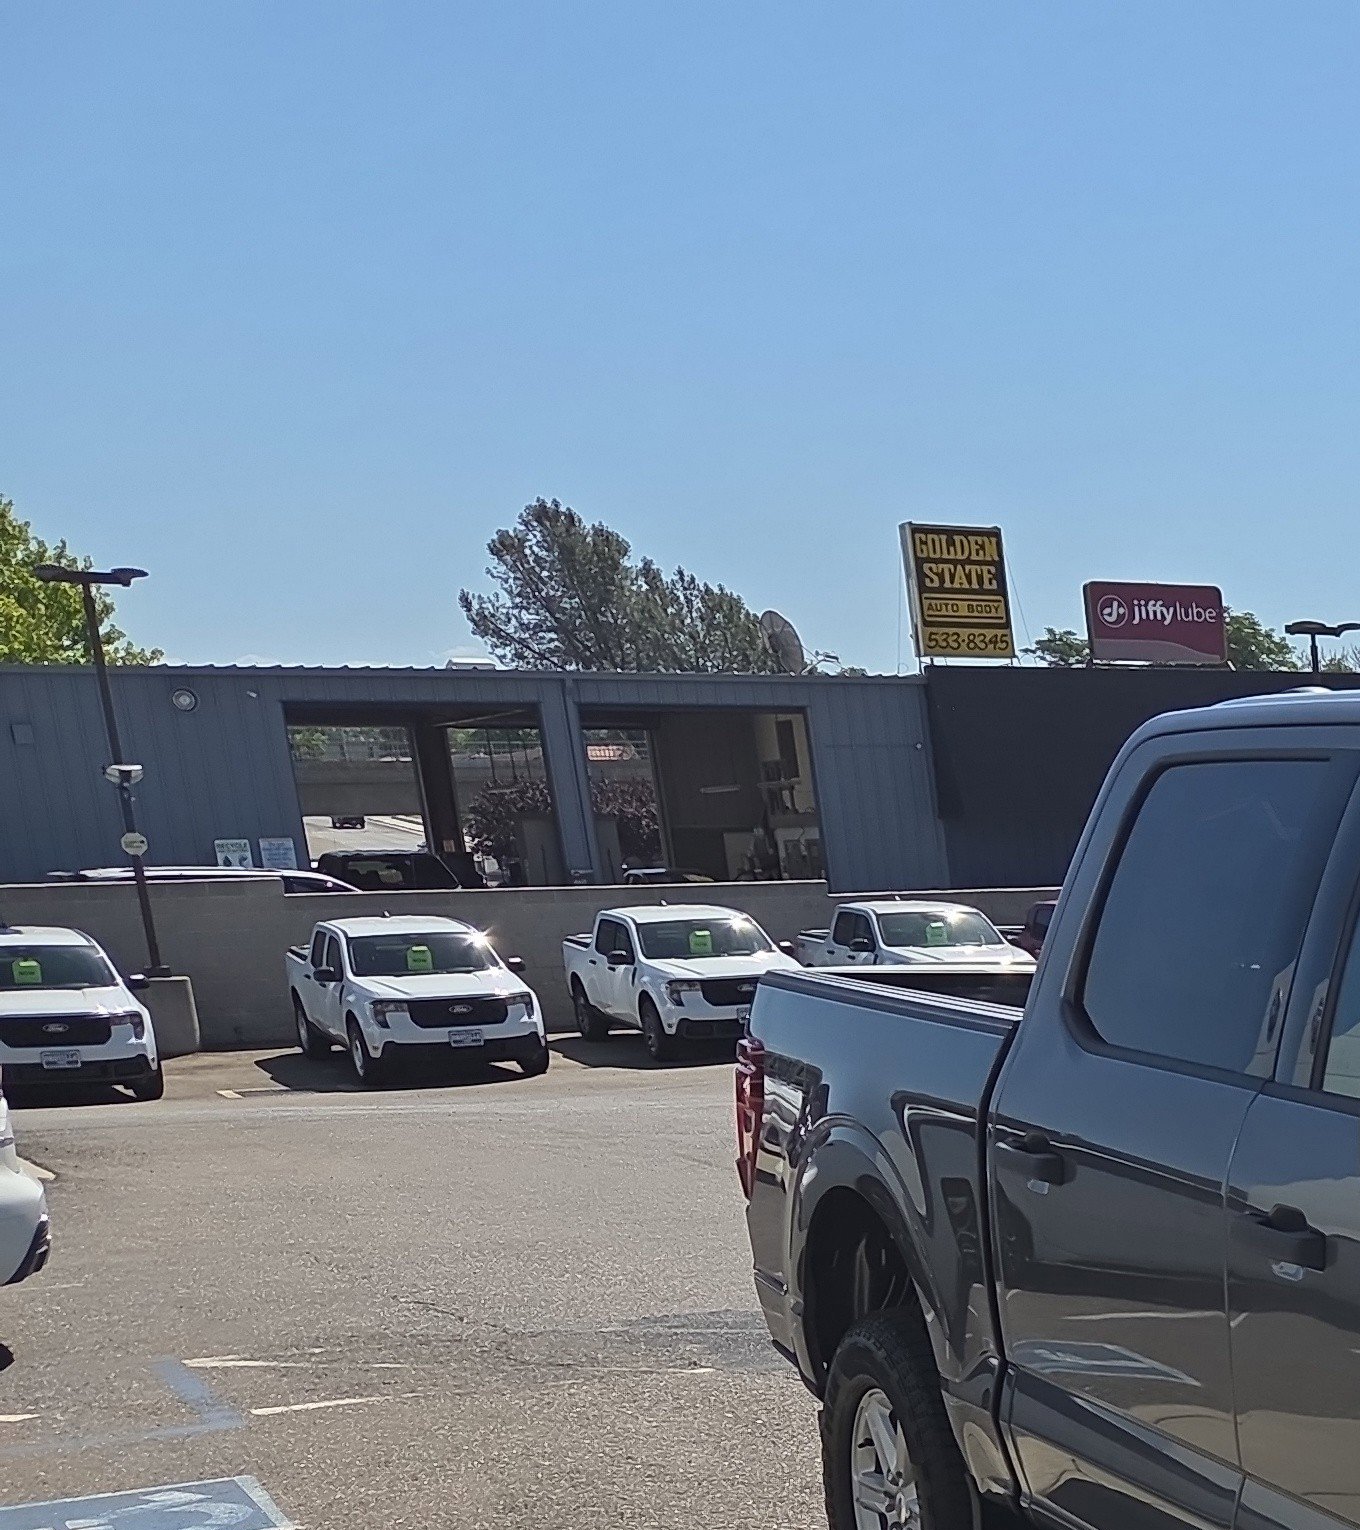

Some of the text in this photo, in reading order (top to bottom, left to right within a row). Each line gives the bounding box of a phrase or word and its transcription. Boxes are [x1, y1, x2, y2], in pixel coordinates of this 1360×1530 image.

[915, 533, 998, 560] GOLDEN
[923, 563, 998, 589] STATE
[927, 602, 1000, 614] AUTO BODY
